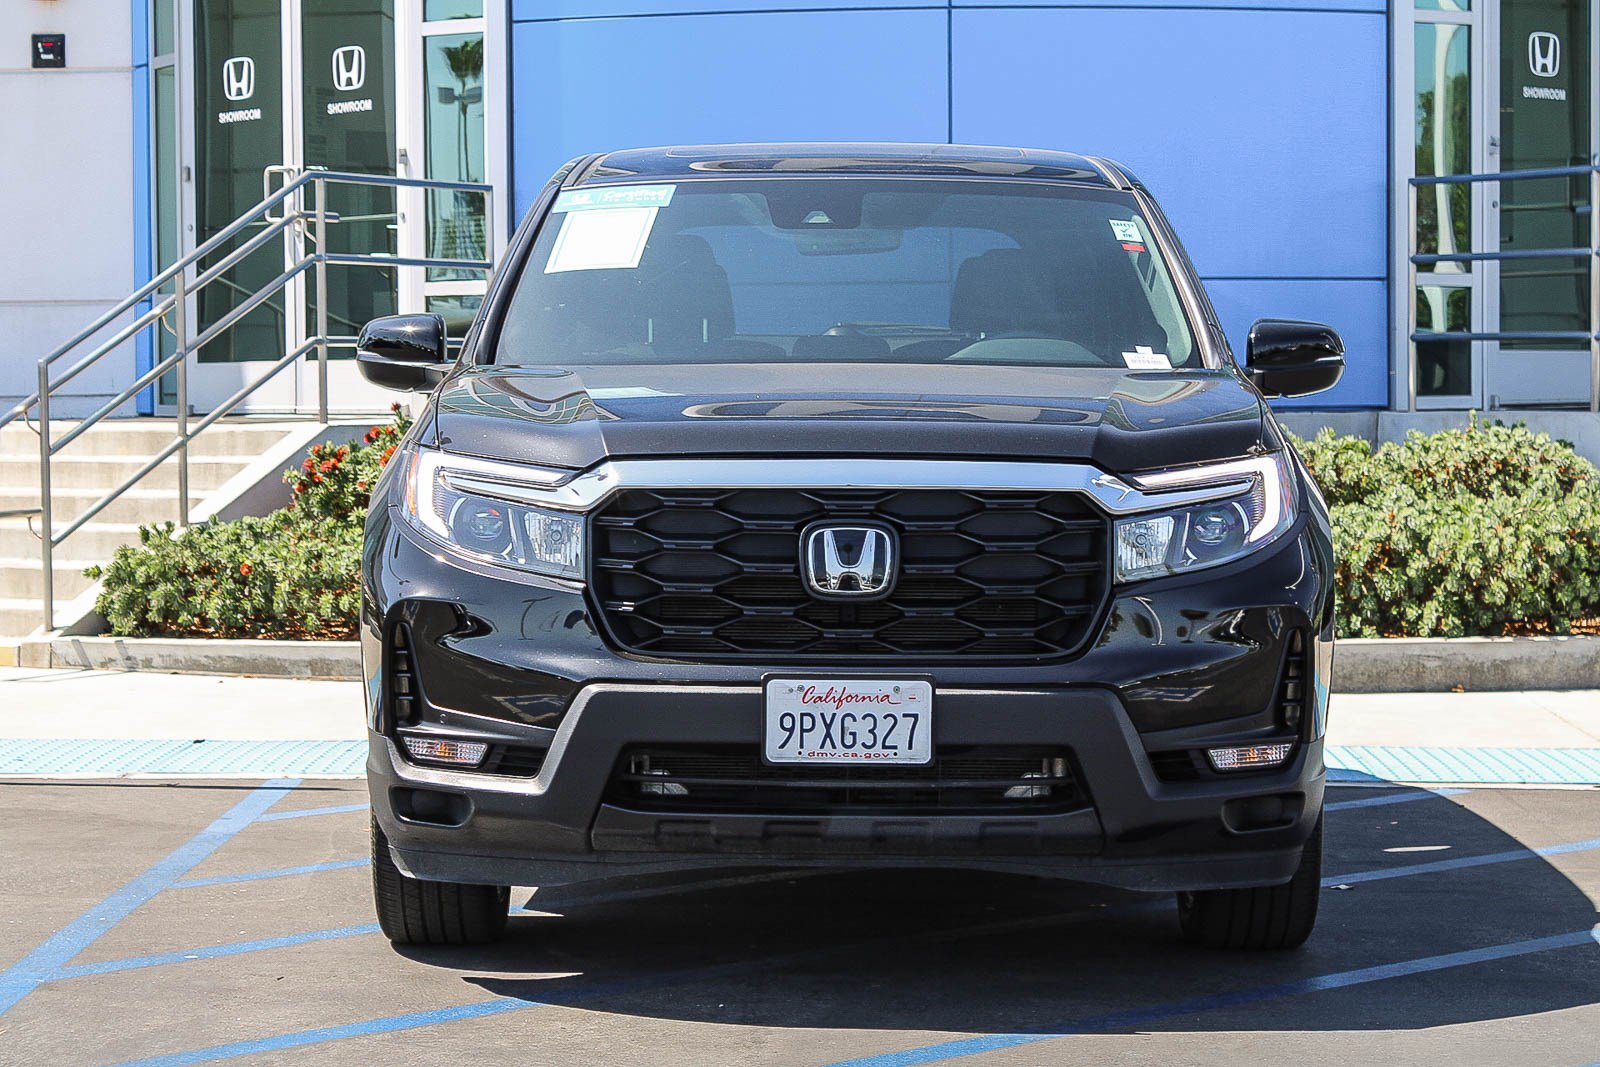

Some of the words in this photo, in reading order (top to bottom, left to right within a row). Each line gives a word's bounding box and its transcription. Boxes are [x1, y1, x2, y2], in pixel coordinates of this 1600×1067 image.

[1522, 86, 1566, 101] SHOWROOM
[327, 99, 372, 114] SHOWROOM
[218, 108, 260, 124] SHOWROOM
[802, 686, 901, 710] California
[778, 712, 919, 750] 9PXG327
[807, 751, 890, 759] dmv.ca.gov
